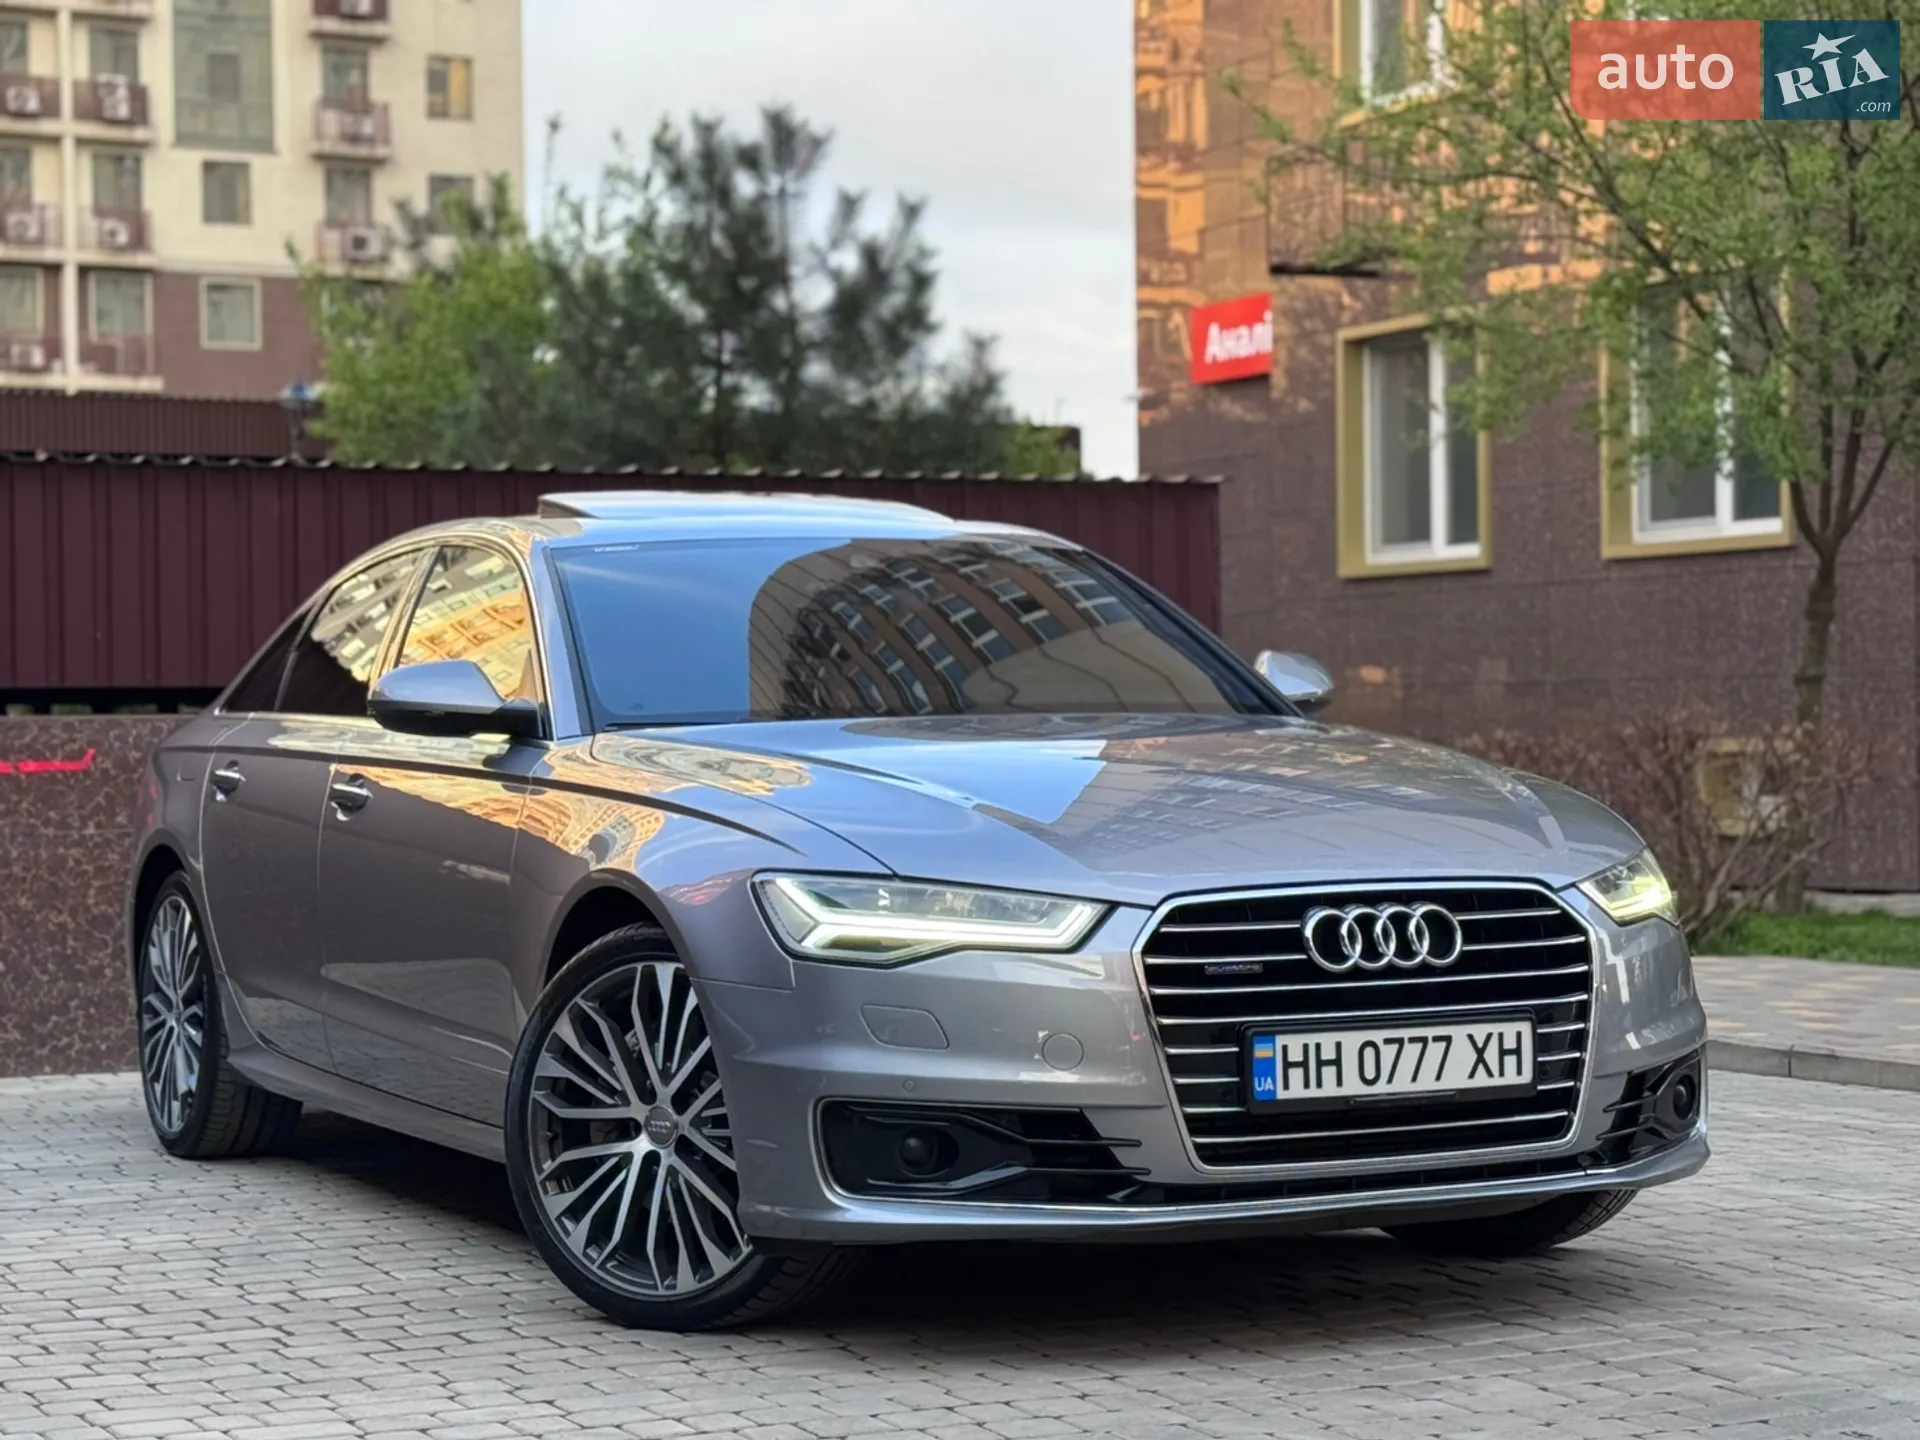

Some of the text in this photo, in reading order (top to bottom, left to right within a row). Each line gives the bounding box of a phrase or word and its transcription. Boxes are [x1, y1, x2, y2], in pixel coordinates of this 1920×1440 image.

[1281, 1030, 1523, 1091] HH 0777 XH
[1255, 1078, 1275, 1092] UA
